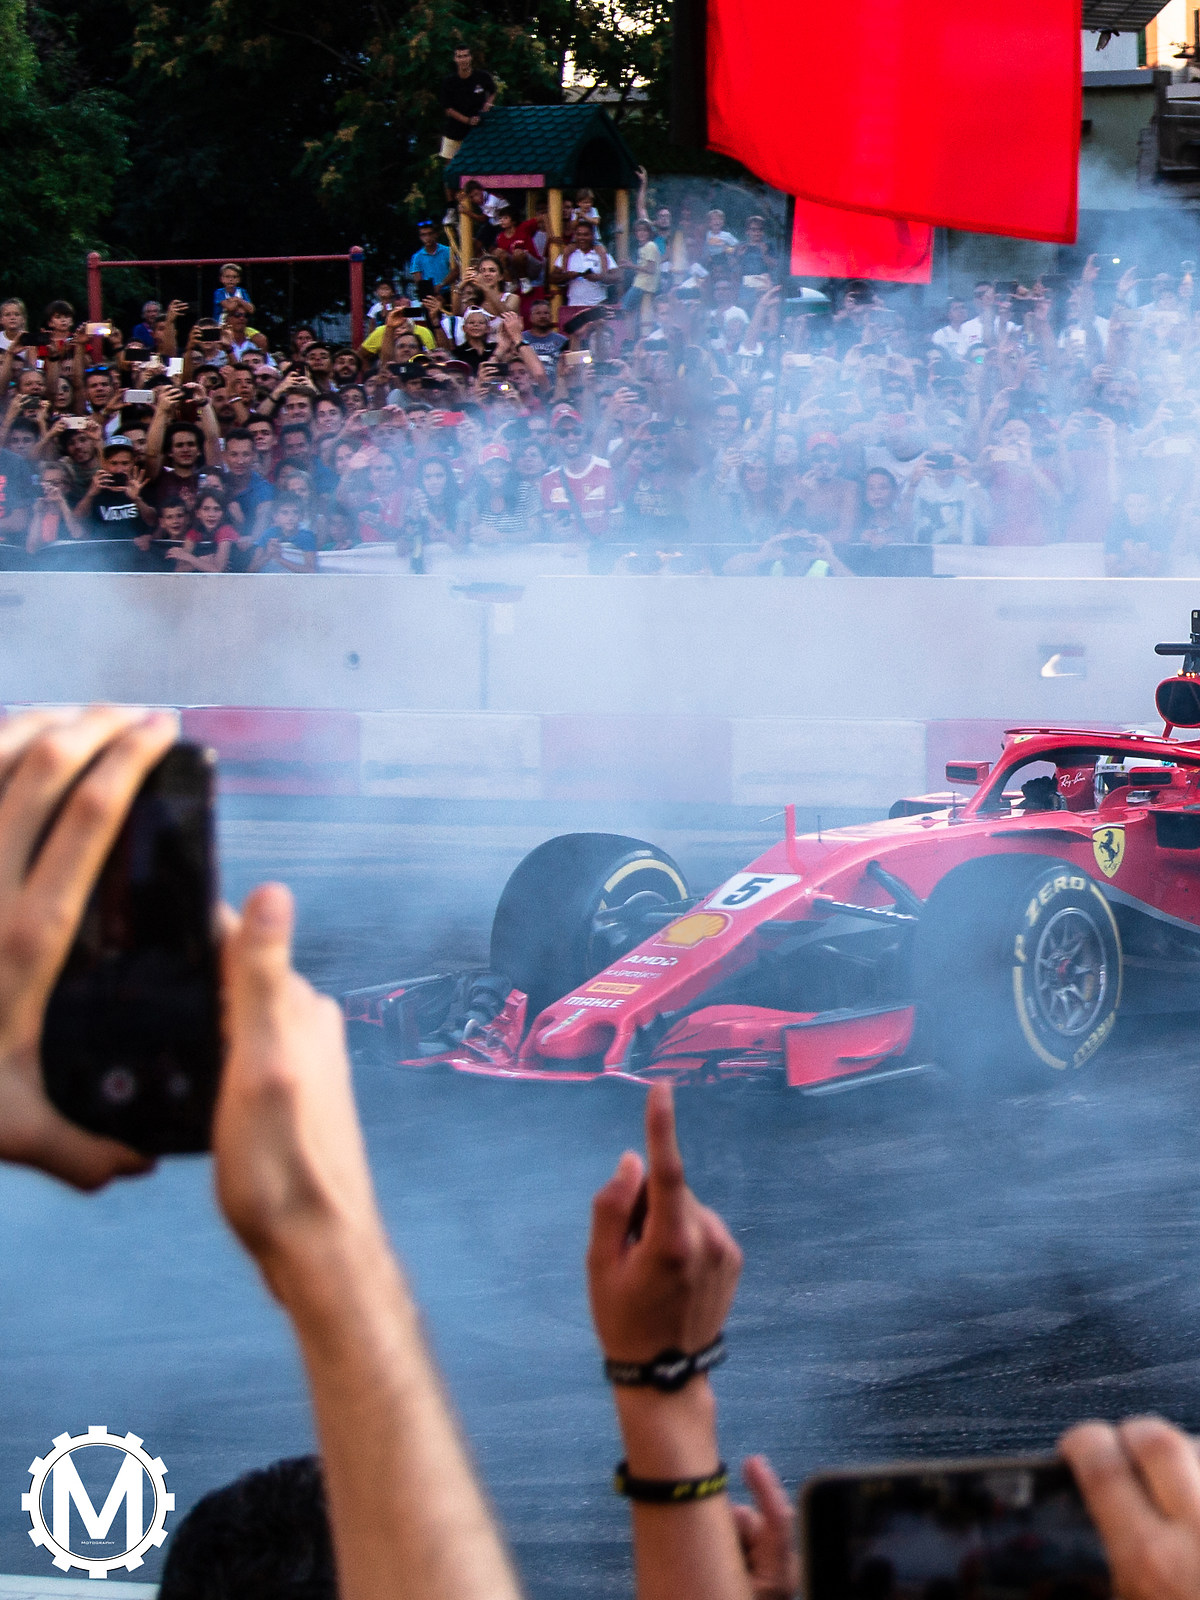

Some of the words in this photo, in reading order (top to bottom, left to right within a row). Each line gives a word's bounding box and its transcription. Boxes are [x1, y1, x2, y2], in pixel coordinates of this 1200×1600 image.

[100, 503, 138, 520] VANS
[722, 877, 775, 906] 5
[1026, 876, 1086, 927] ZERO
[623, 954, 665, 966] AMD
[564, 996, 626, 1008] MAHLE
